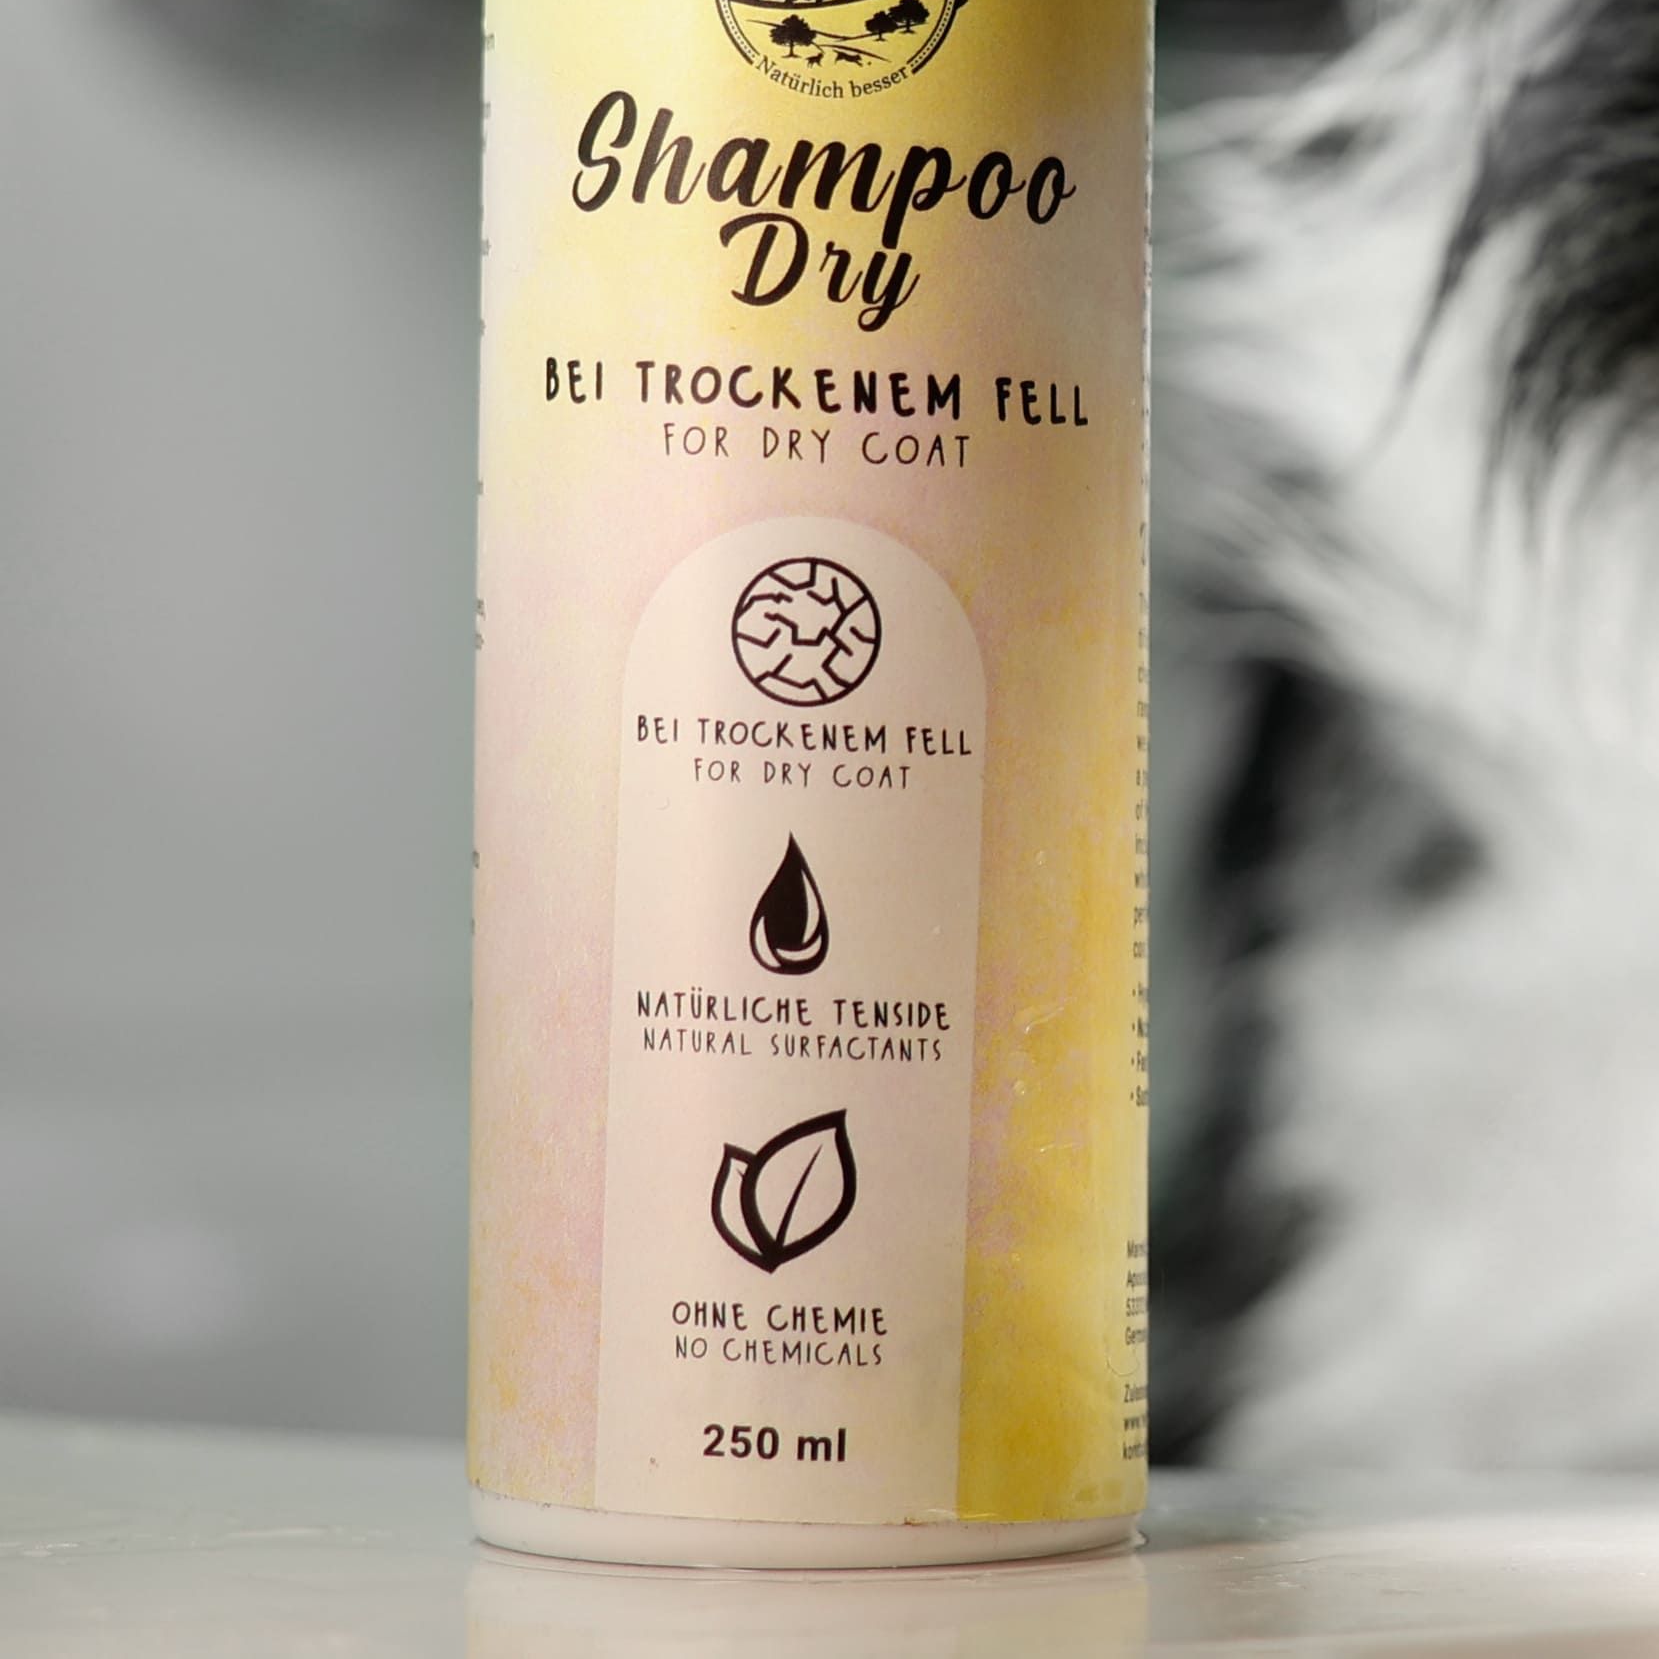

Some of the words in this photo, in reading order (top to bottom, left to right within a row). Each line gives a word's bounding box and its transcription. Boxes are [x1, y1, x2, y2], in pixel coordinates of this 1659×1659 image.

[755, 55, 844, 99] Natürlich
[849, 66, 909, 98] besser
[571, 90, 1077, 248] Shampoo
[719, 212, 921, 332] Dry
[545, 356, 603, 405] BEI
[635, 360, 961, 421] TROCKENEM
[994, 376, 1089, 427] FELL
[663, 422, 729, 457] FOR
[763, 426, 831, 464] DRY
[861, 431, 970, 468] COAT
[637, 714, 678, 744] BEI
[697, 718, 886, 754] TROCKENEM
[905, 725, 972, 757] FELL
[694, 757, 740, 782] FOR
[764, 760, 811, 787] DRY
[832, 764, 911, 790] COAT
[636, 986, 811, 1027] NATÜRLICHE
[832, 998, 951, 1032] TENSIDE
[644, 1027, 752, 1056] NATURAL
[770, 1033, 941, 1062] SURFACTANTS
[672, 1301, 748, 1331] OHNE
[766, 1304, 888, 1337] CHEMIE
[675, 1335, 708, 1359] NO
[722, 1337, 882, 1367] CHEMICALS
[703, 1423, 780, 1460] 250
[796, 1427, 847, 1463] ml
